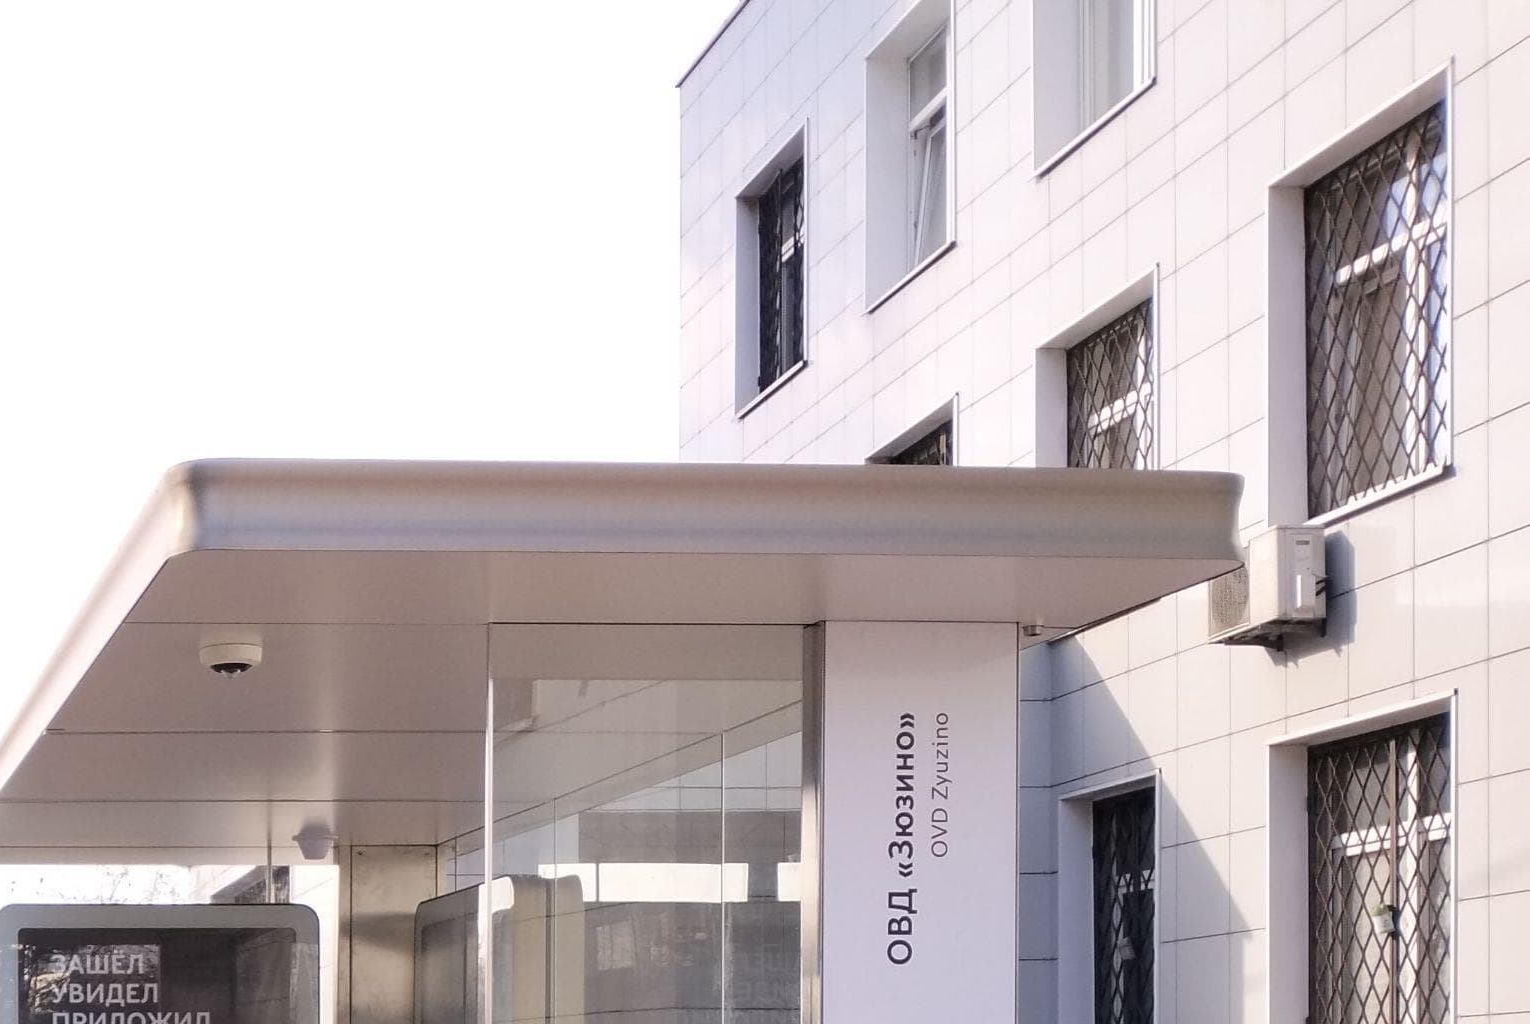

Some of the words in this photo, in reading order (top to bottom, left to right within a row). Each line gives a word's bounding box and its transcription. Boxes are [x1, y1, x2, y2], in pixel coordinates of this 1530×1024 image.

[932, 712, 953, 800] Zyuzino
[888, 712, 915, 878] «Зюзино»
[931, 807, 949, 858] OVD
[887, 888, 918, 965] ОВД
[52, 950, 145, 975] ЗАШЁЛ
[52, 982, 158, 1008] УВИДЕЛ
